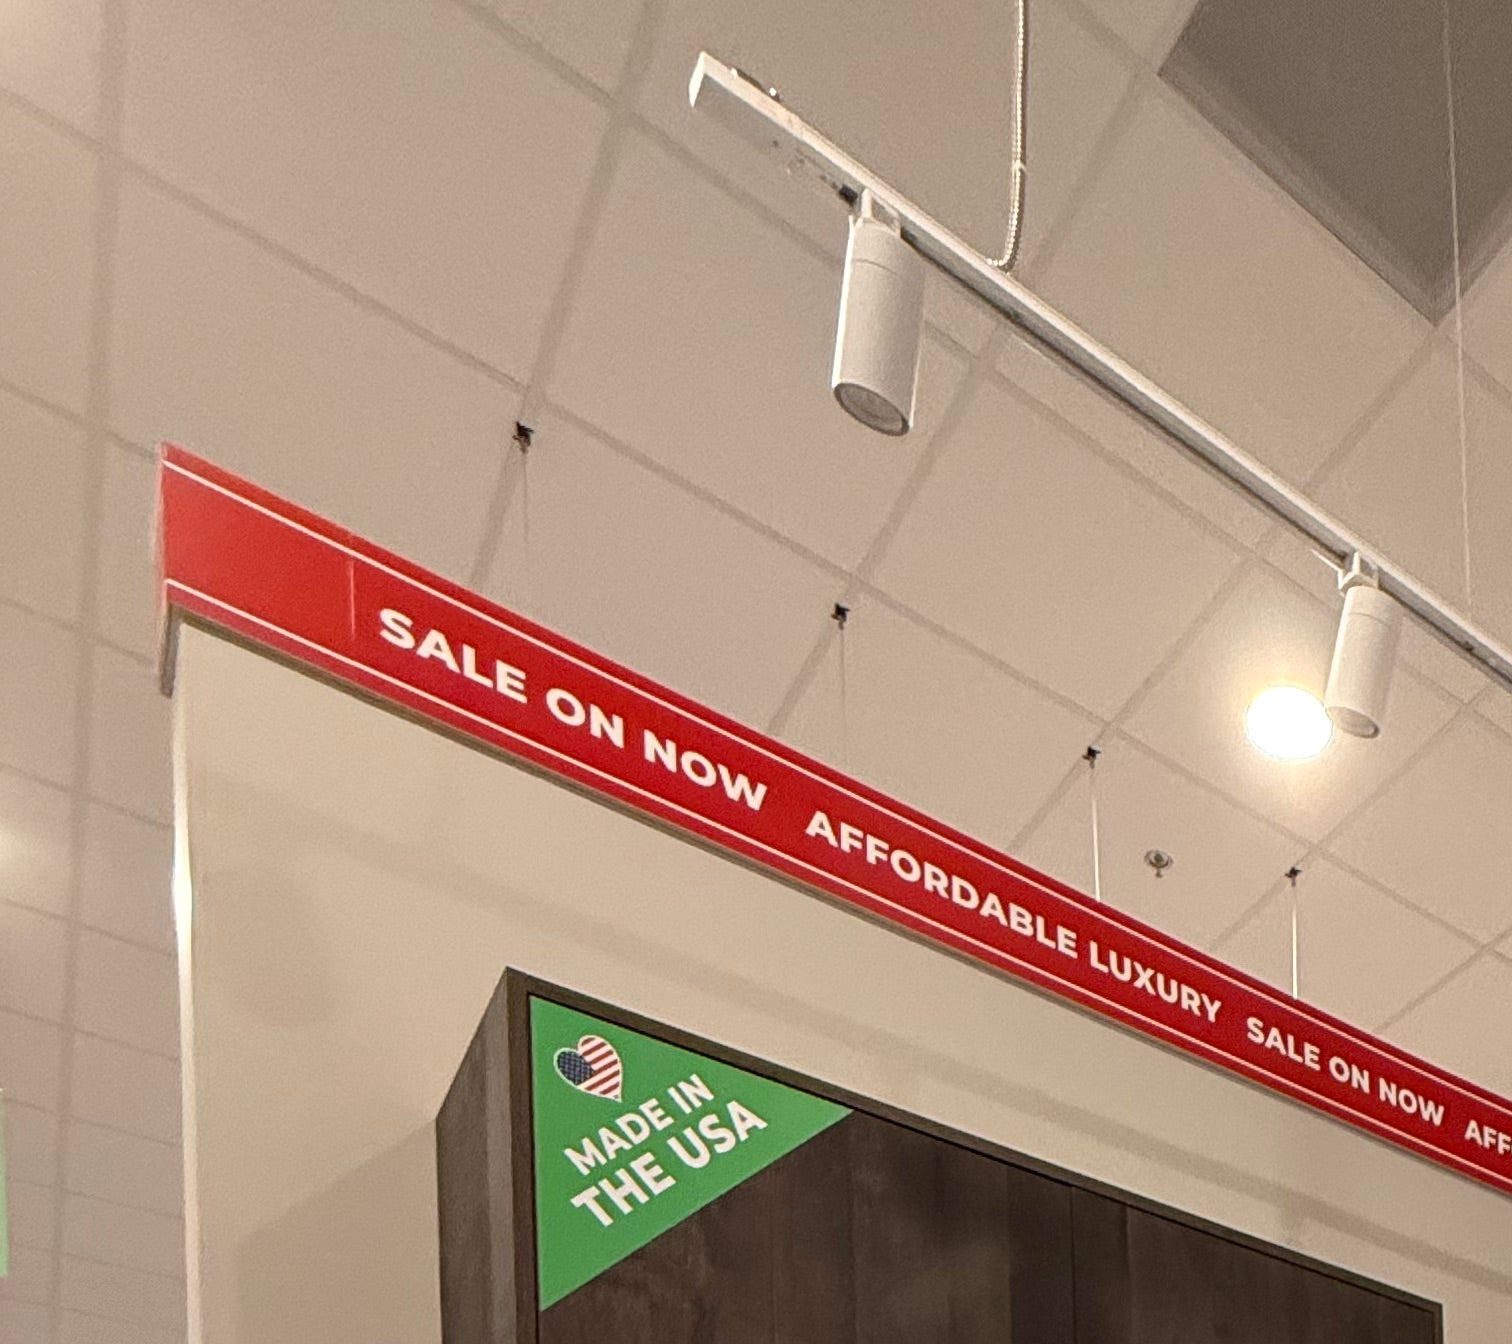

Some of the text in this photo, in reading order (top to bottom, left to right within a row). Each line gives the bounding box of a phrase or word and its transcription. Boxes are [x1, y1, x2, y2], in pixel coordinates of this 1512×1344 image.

[379, 608, 527, 703] SALE
[546, 689, 624, 747] ON
[644, 729, 767, 811] NOW
[805, 811, 1078, 958] AFFORDABLE
[1090, 941, 1222, 1023] LUXURY
[1246, 1016, 1320, 1071] SALE
[1329, 1056, 1370, 1093] ON
[1379, 1073, 1444, 1126] NOW
[564, 1073, 714, 1176] MADE IN
[570, 1100, 768, 1227] THE USA
